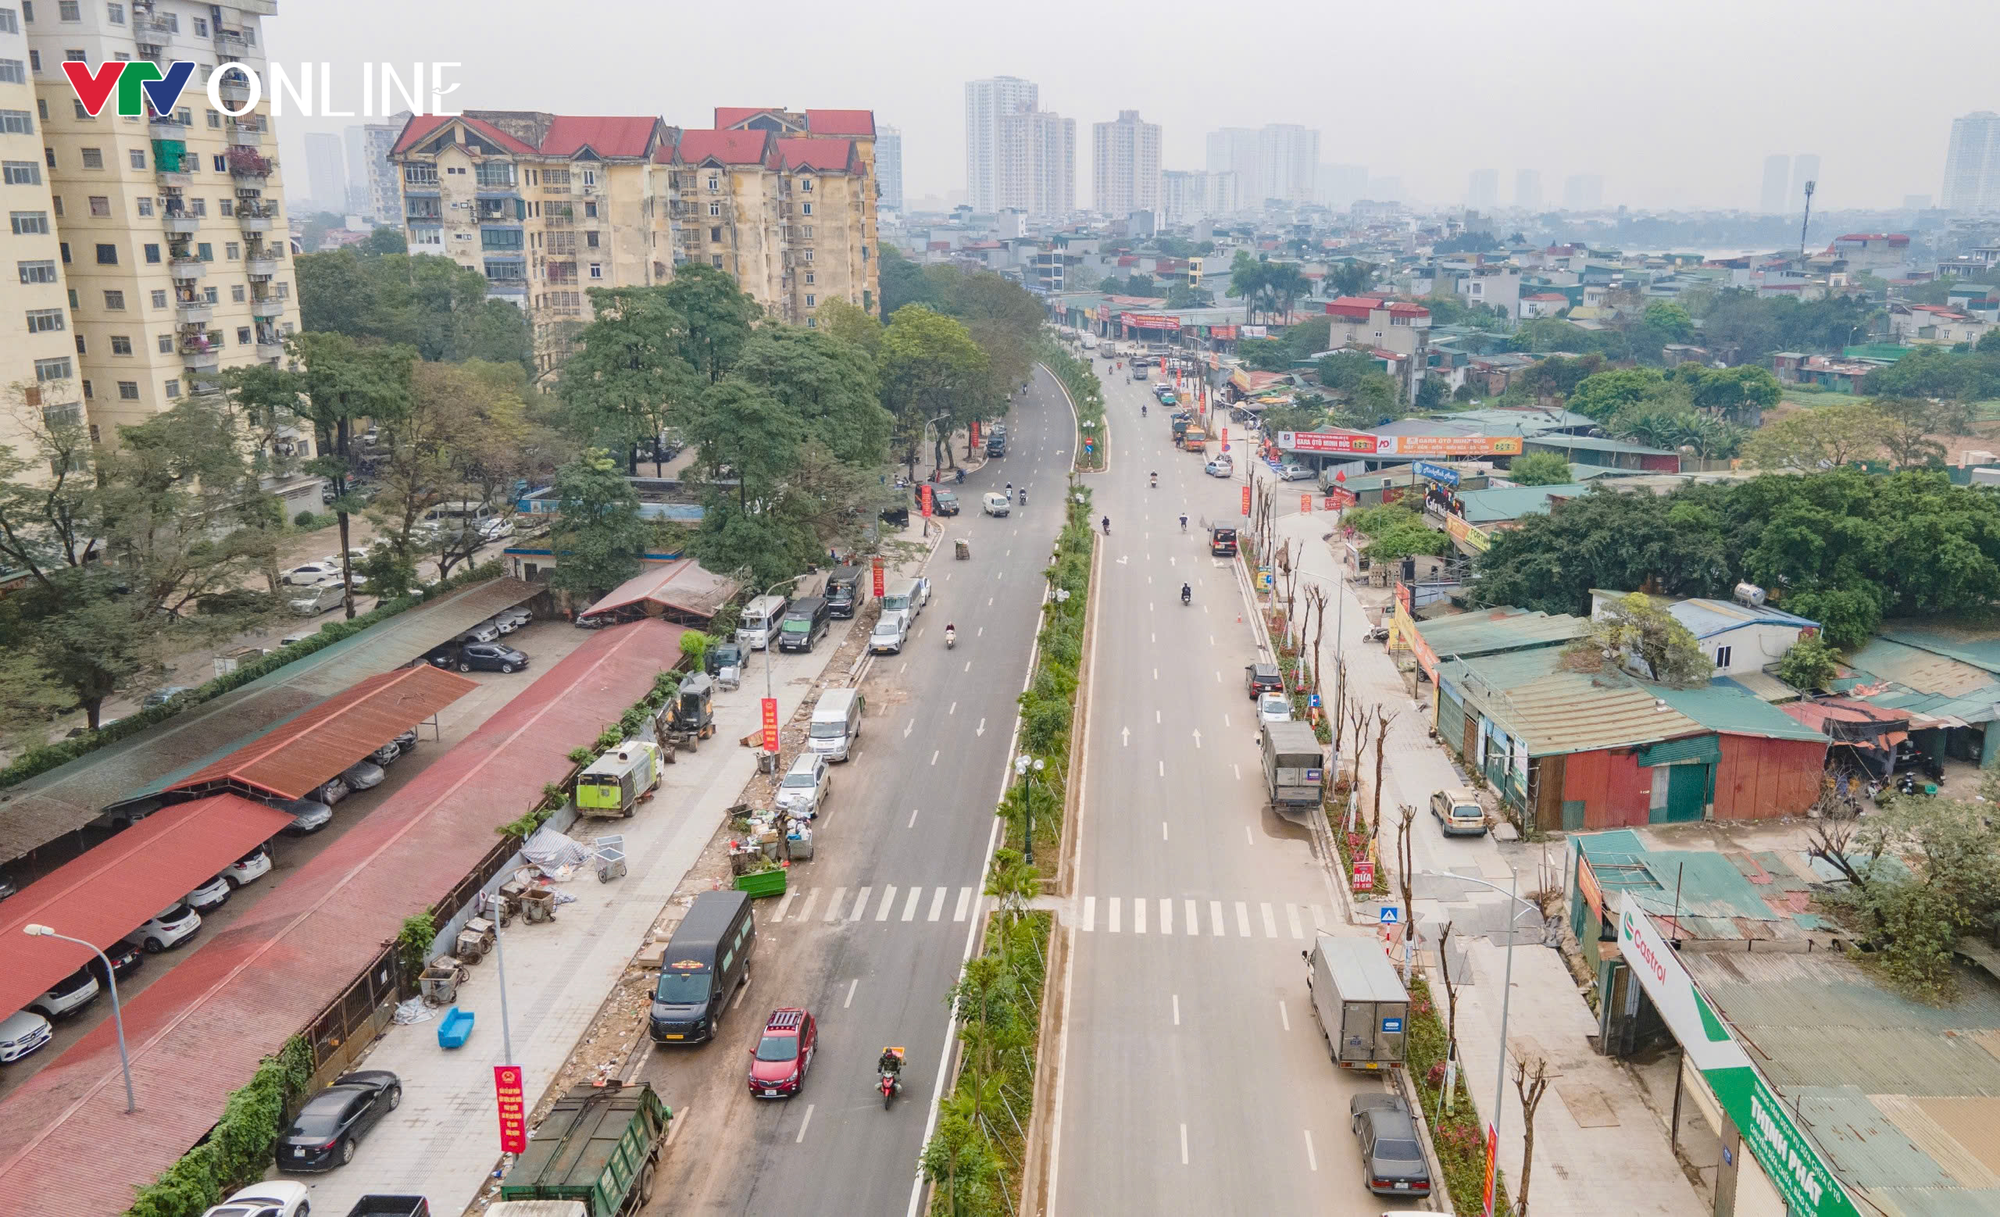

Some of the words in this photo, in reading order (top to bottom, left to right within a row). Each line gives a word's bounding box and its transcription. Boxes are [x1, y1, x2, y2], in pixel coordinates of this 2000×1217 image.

[1634, 929, 1667, 986] Castrol
[1751, 1095, 1788, 1162] THỊNH
[1788, 1149, 1822, 1206] PHÁT
[1770, 1103, 1780, 1120] TÂM
[1833, 1188, 1840, 1203] TÔ
